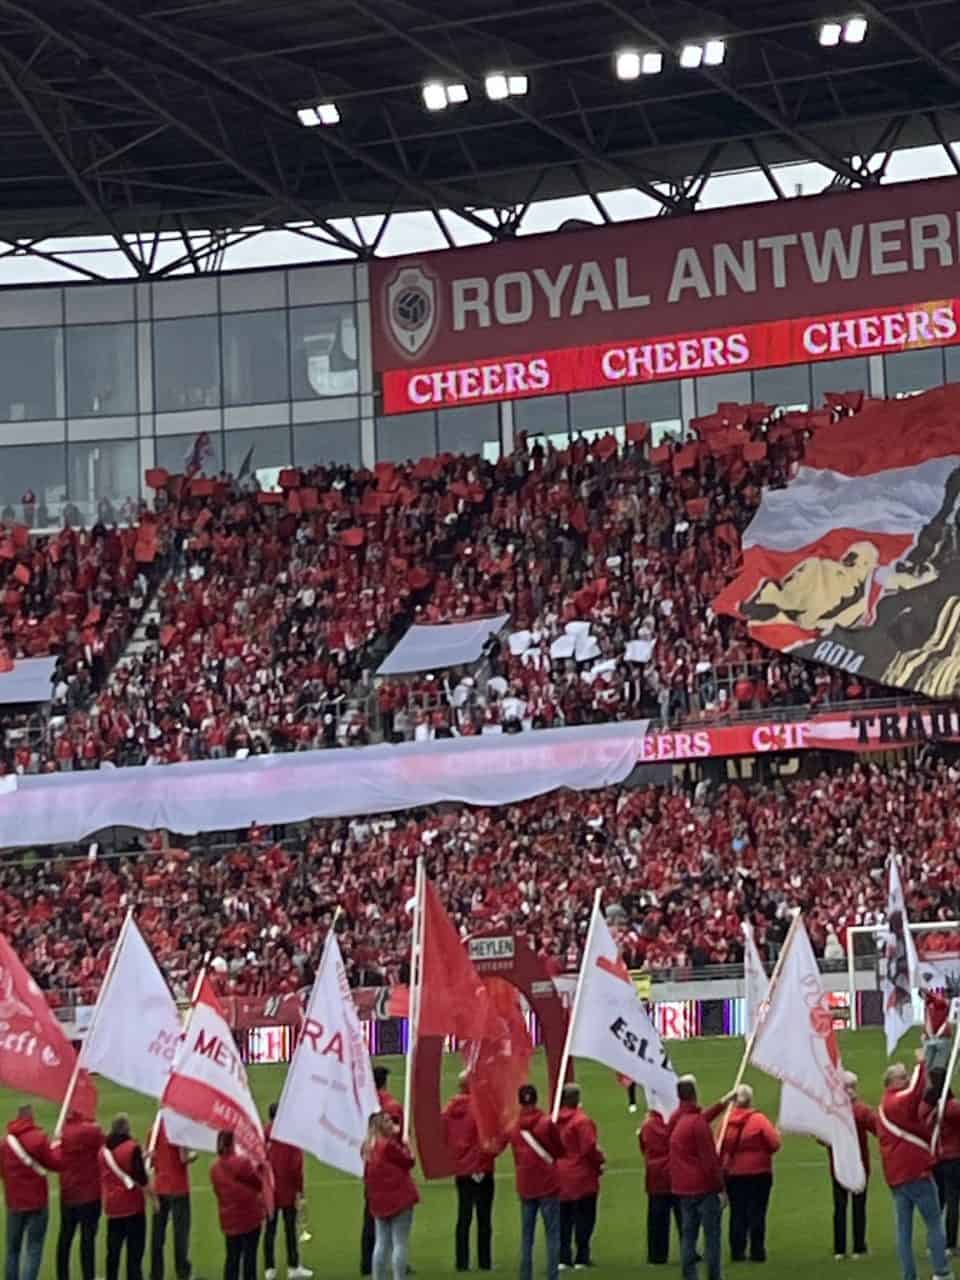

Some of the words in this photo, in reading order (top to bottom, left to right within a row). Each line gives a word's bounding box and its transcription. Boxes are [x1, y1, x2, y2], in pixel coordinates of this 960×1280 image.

[452, 257, 650, 331] ROYAL
[802, 307, 958, 354] CHEERS
[602, 333, 750, 379] CHEERS
[407, 358, 551, 405] CHEERS
